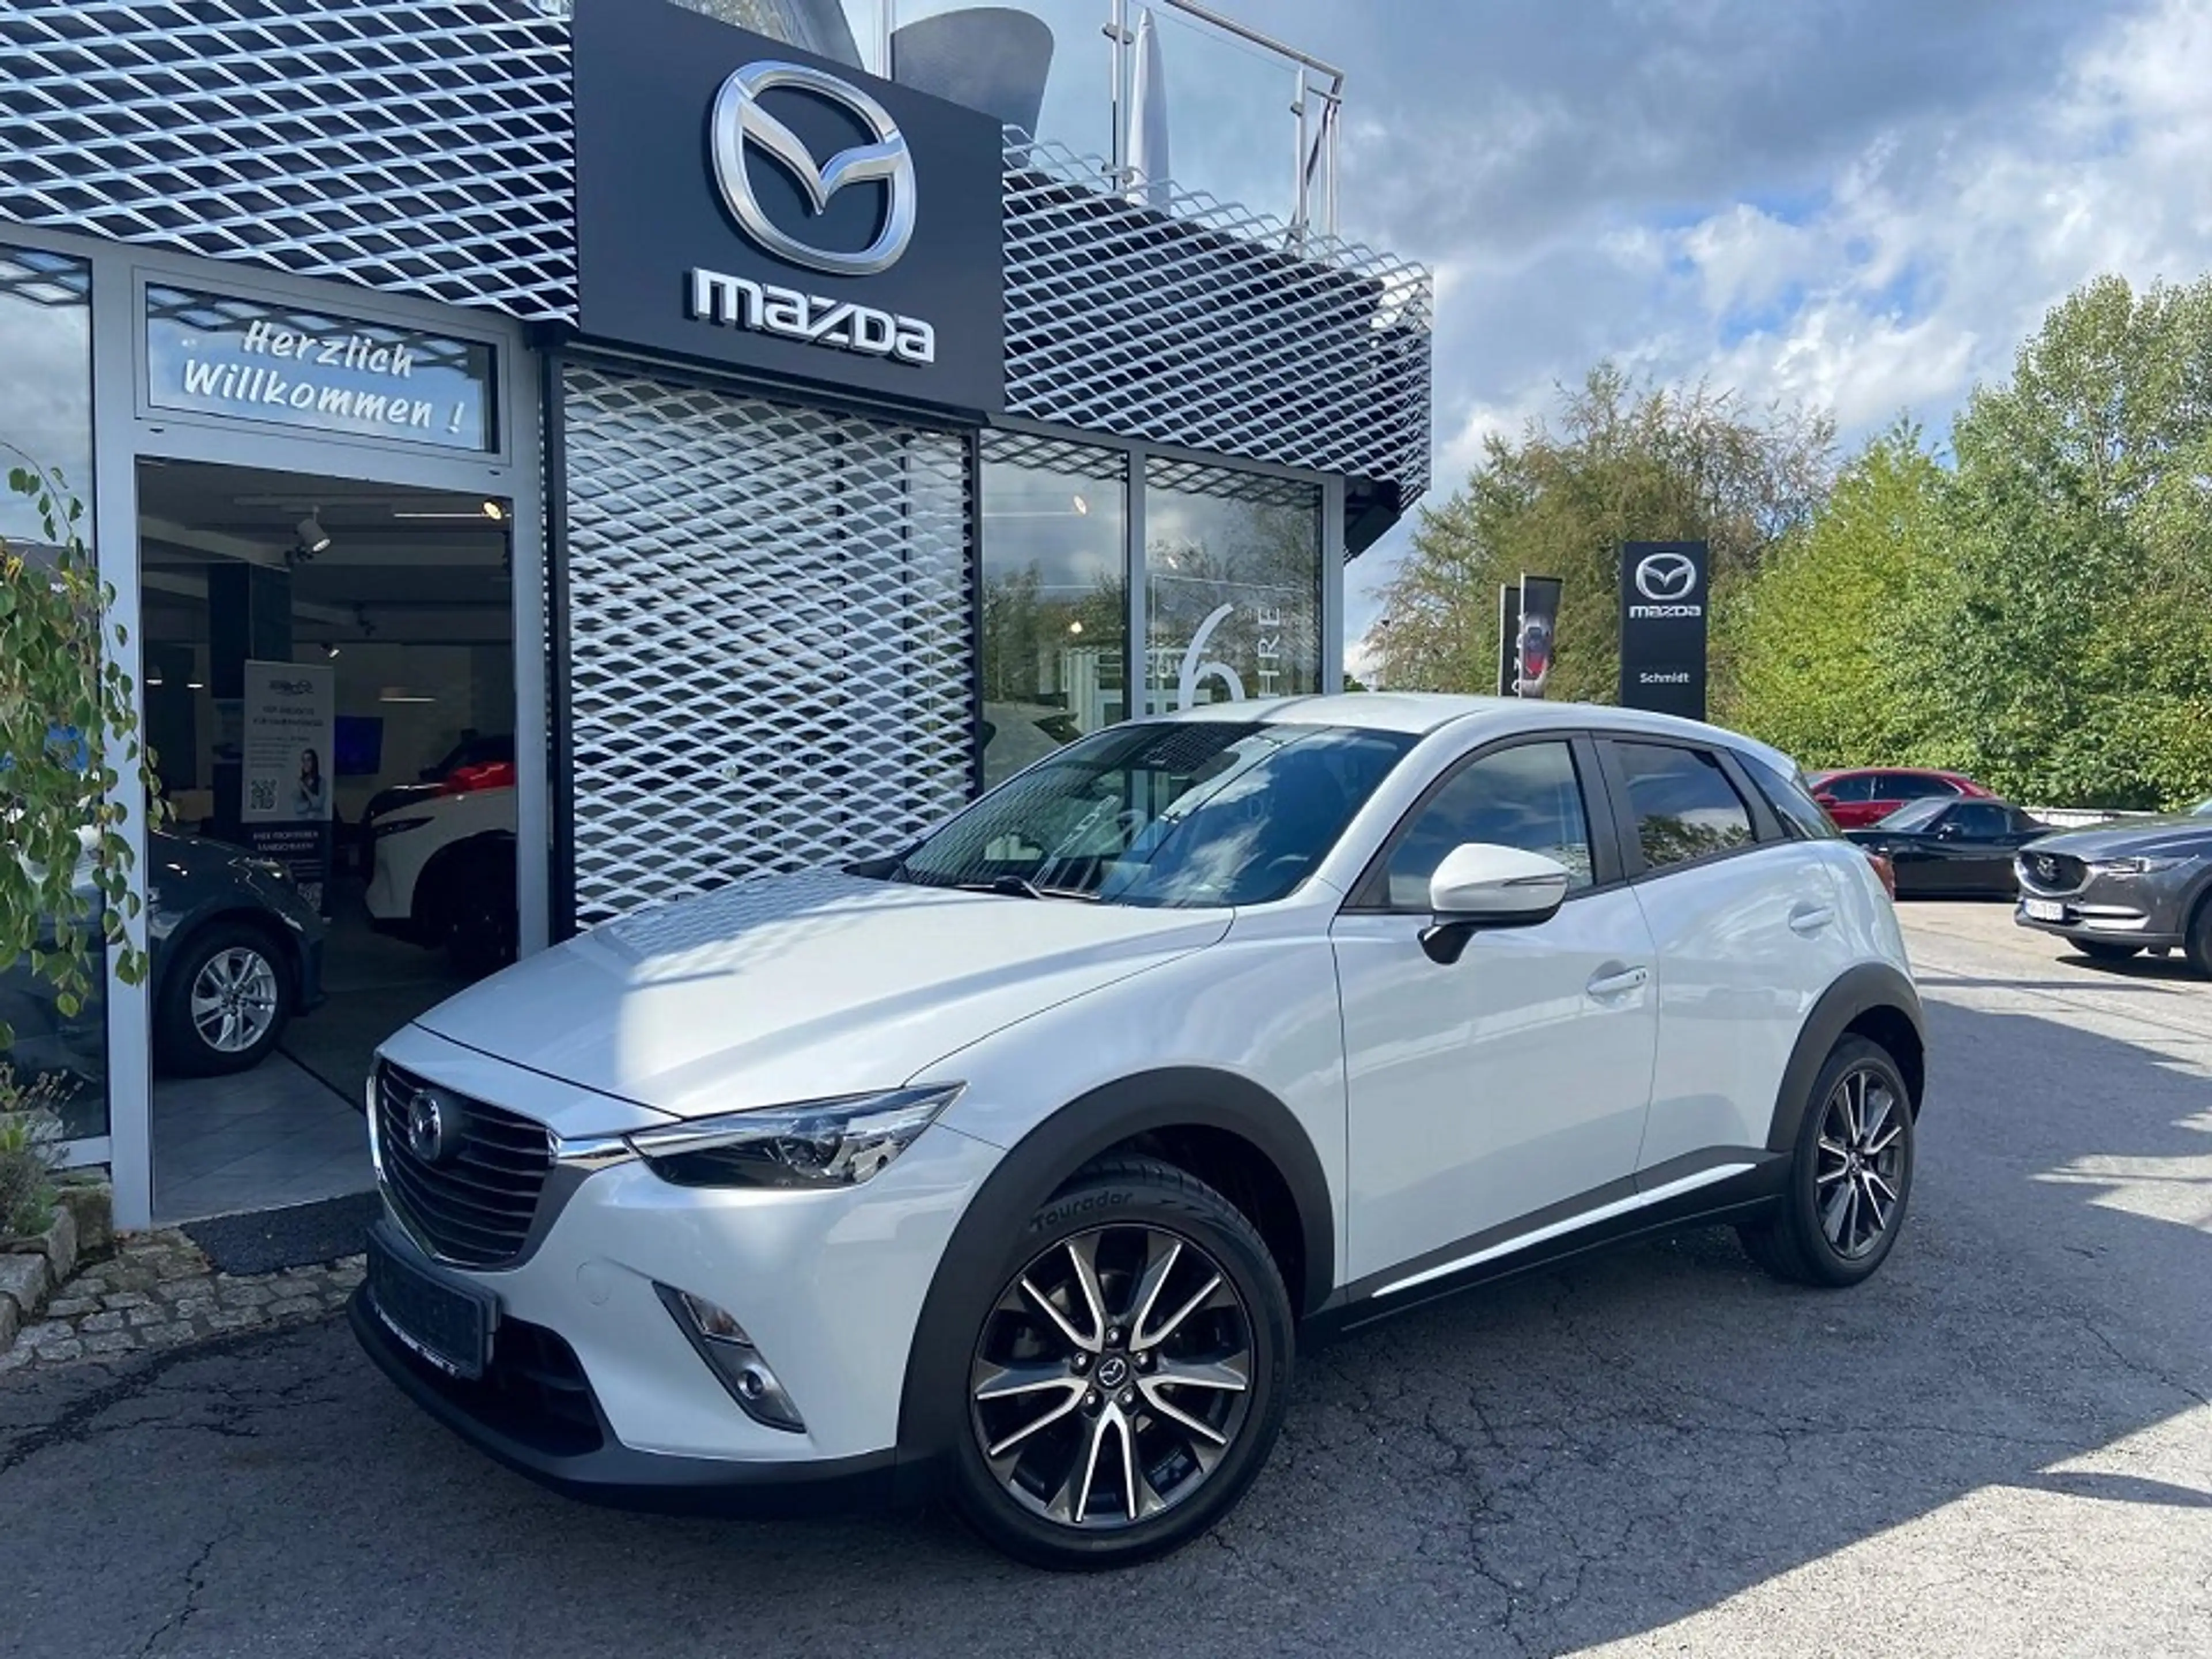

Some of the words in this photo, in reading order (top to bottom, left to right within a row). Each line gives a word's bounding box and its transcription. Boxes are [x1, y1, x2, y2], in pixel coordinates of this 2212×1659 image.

[243, 320, 413, 378] Herzlich
[182, 359, 431, 428] Willkommen
[1640, 672, 1691, 684] Schmidt
[1029, 1191, 1134, 1231] Tourador
